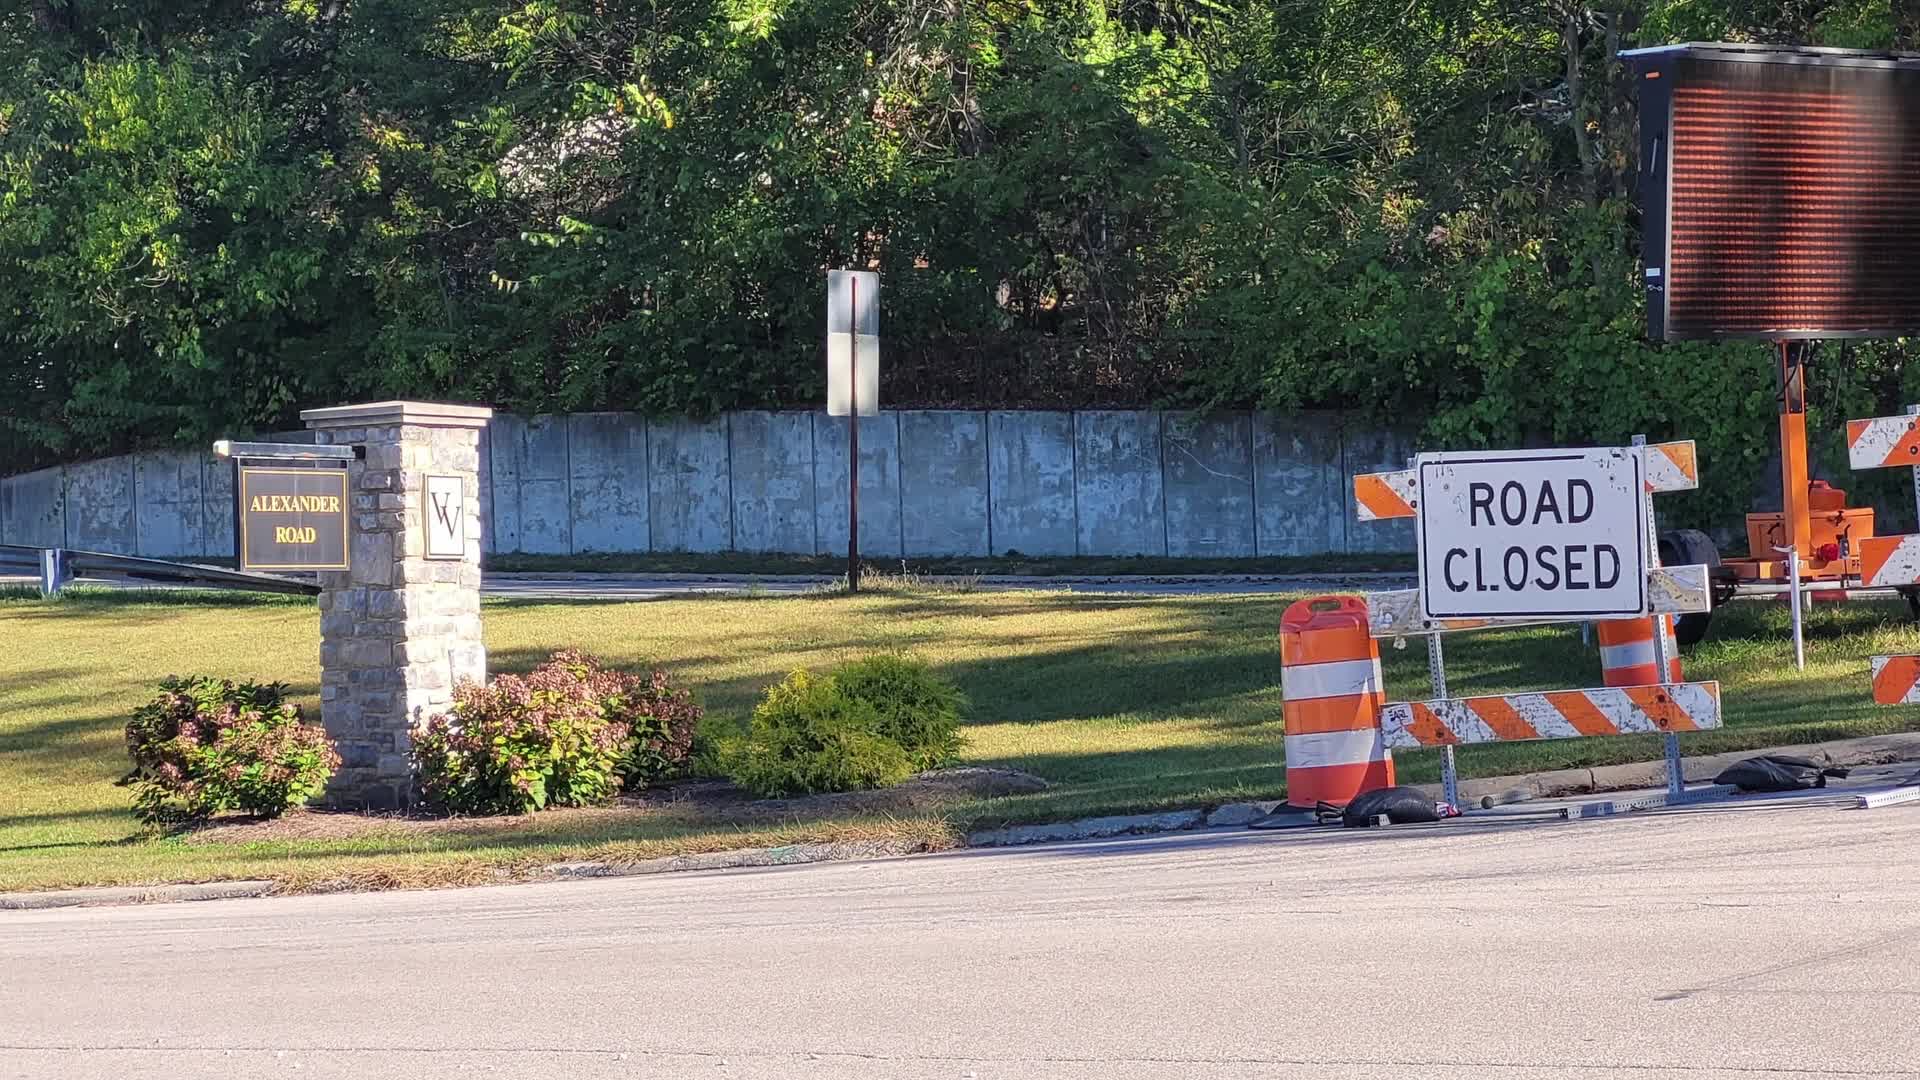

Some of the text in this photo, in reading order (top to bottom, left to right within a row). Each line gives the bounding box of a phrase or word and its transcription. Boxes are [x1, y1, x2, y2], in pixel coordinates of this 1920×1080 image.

[250, 495, 340, 512] ALEXANDER
[1469, 478, 1594, 527] ROAD
[275, 526, 317, 543] ROAD
[1443, 544, 1621, 593] CLOSED
